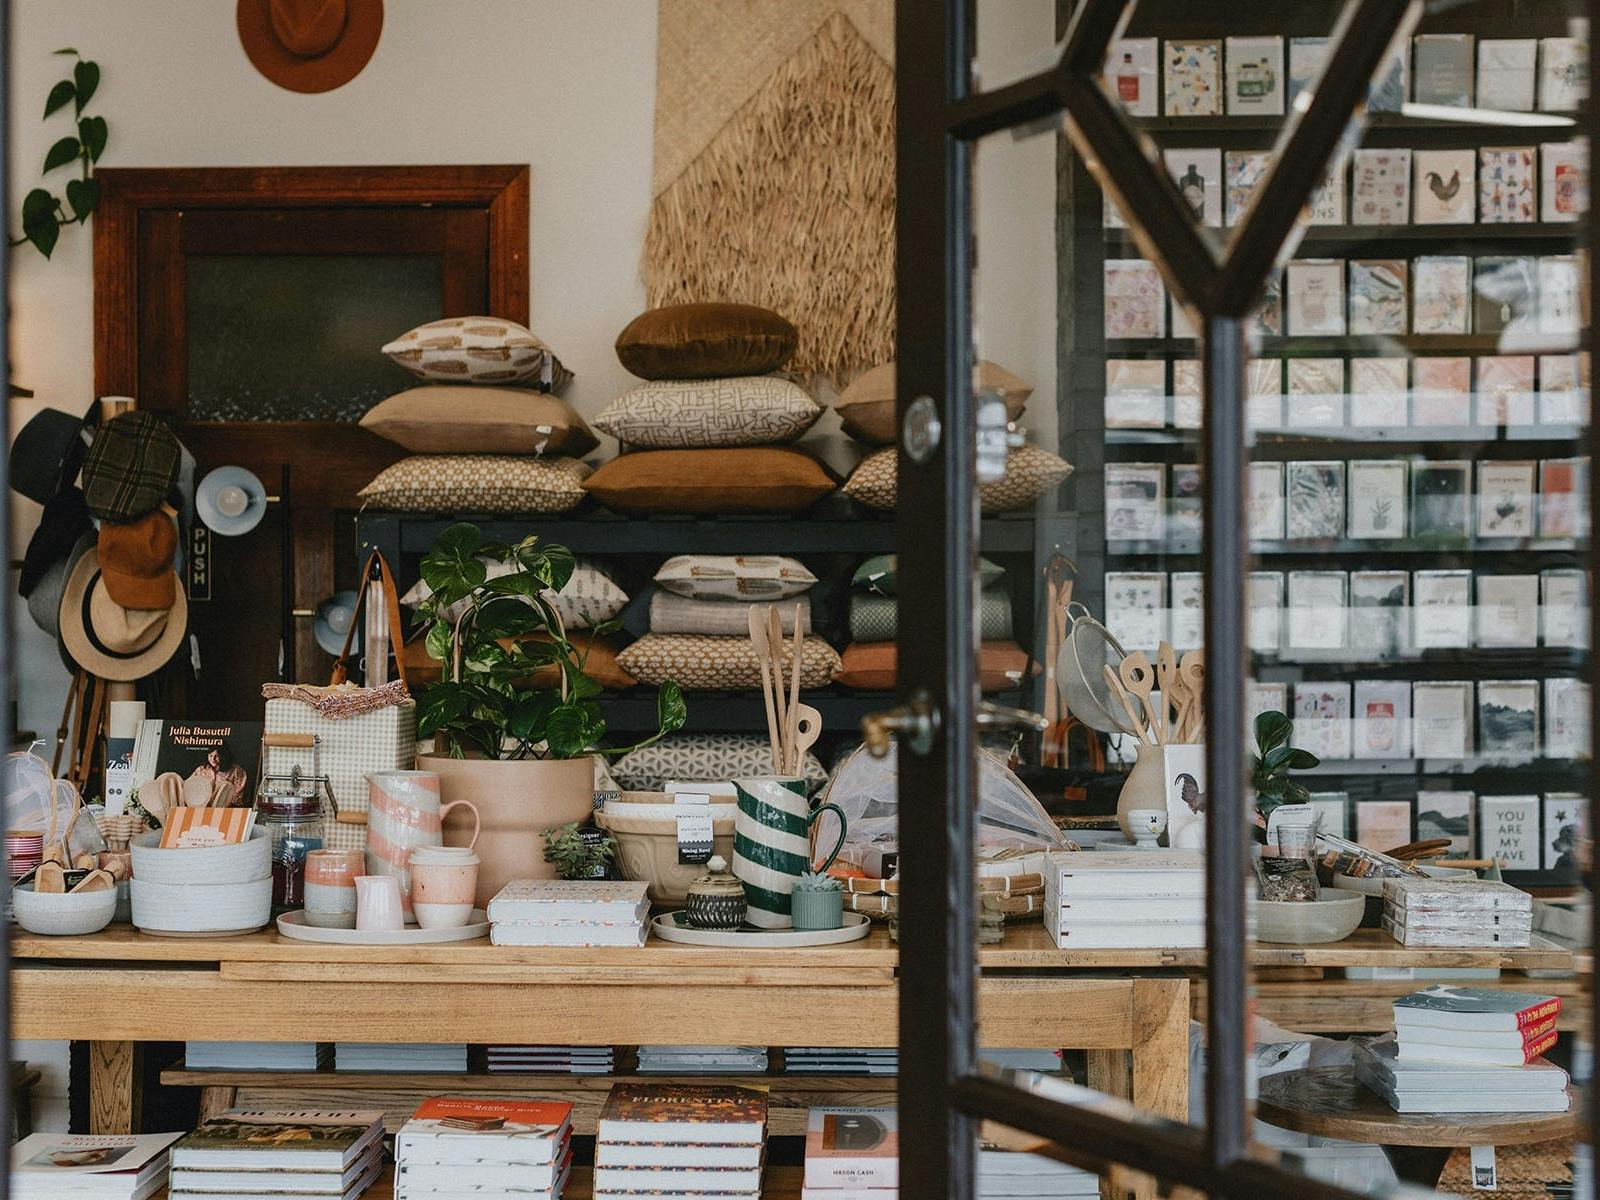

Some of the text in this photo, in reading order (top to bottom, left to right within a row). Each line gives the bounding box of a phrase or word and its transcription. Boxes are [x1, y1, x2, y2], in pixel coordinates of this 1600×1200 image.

[193, 527, 206, 585] PUSH
[169, 726, 231, 737] Julia Busuttil
[173, 736, 224, 746] Nishimura
[1496, 811, 1526, 821] YOU
[1498, 825, 1523, 834] ARE
[1500, 838, 1521, 848] MY
[1495, 851, 1526, 861] FAVE
[632, 1096, 748, 1105] FLORENTINE
